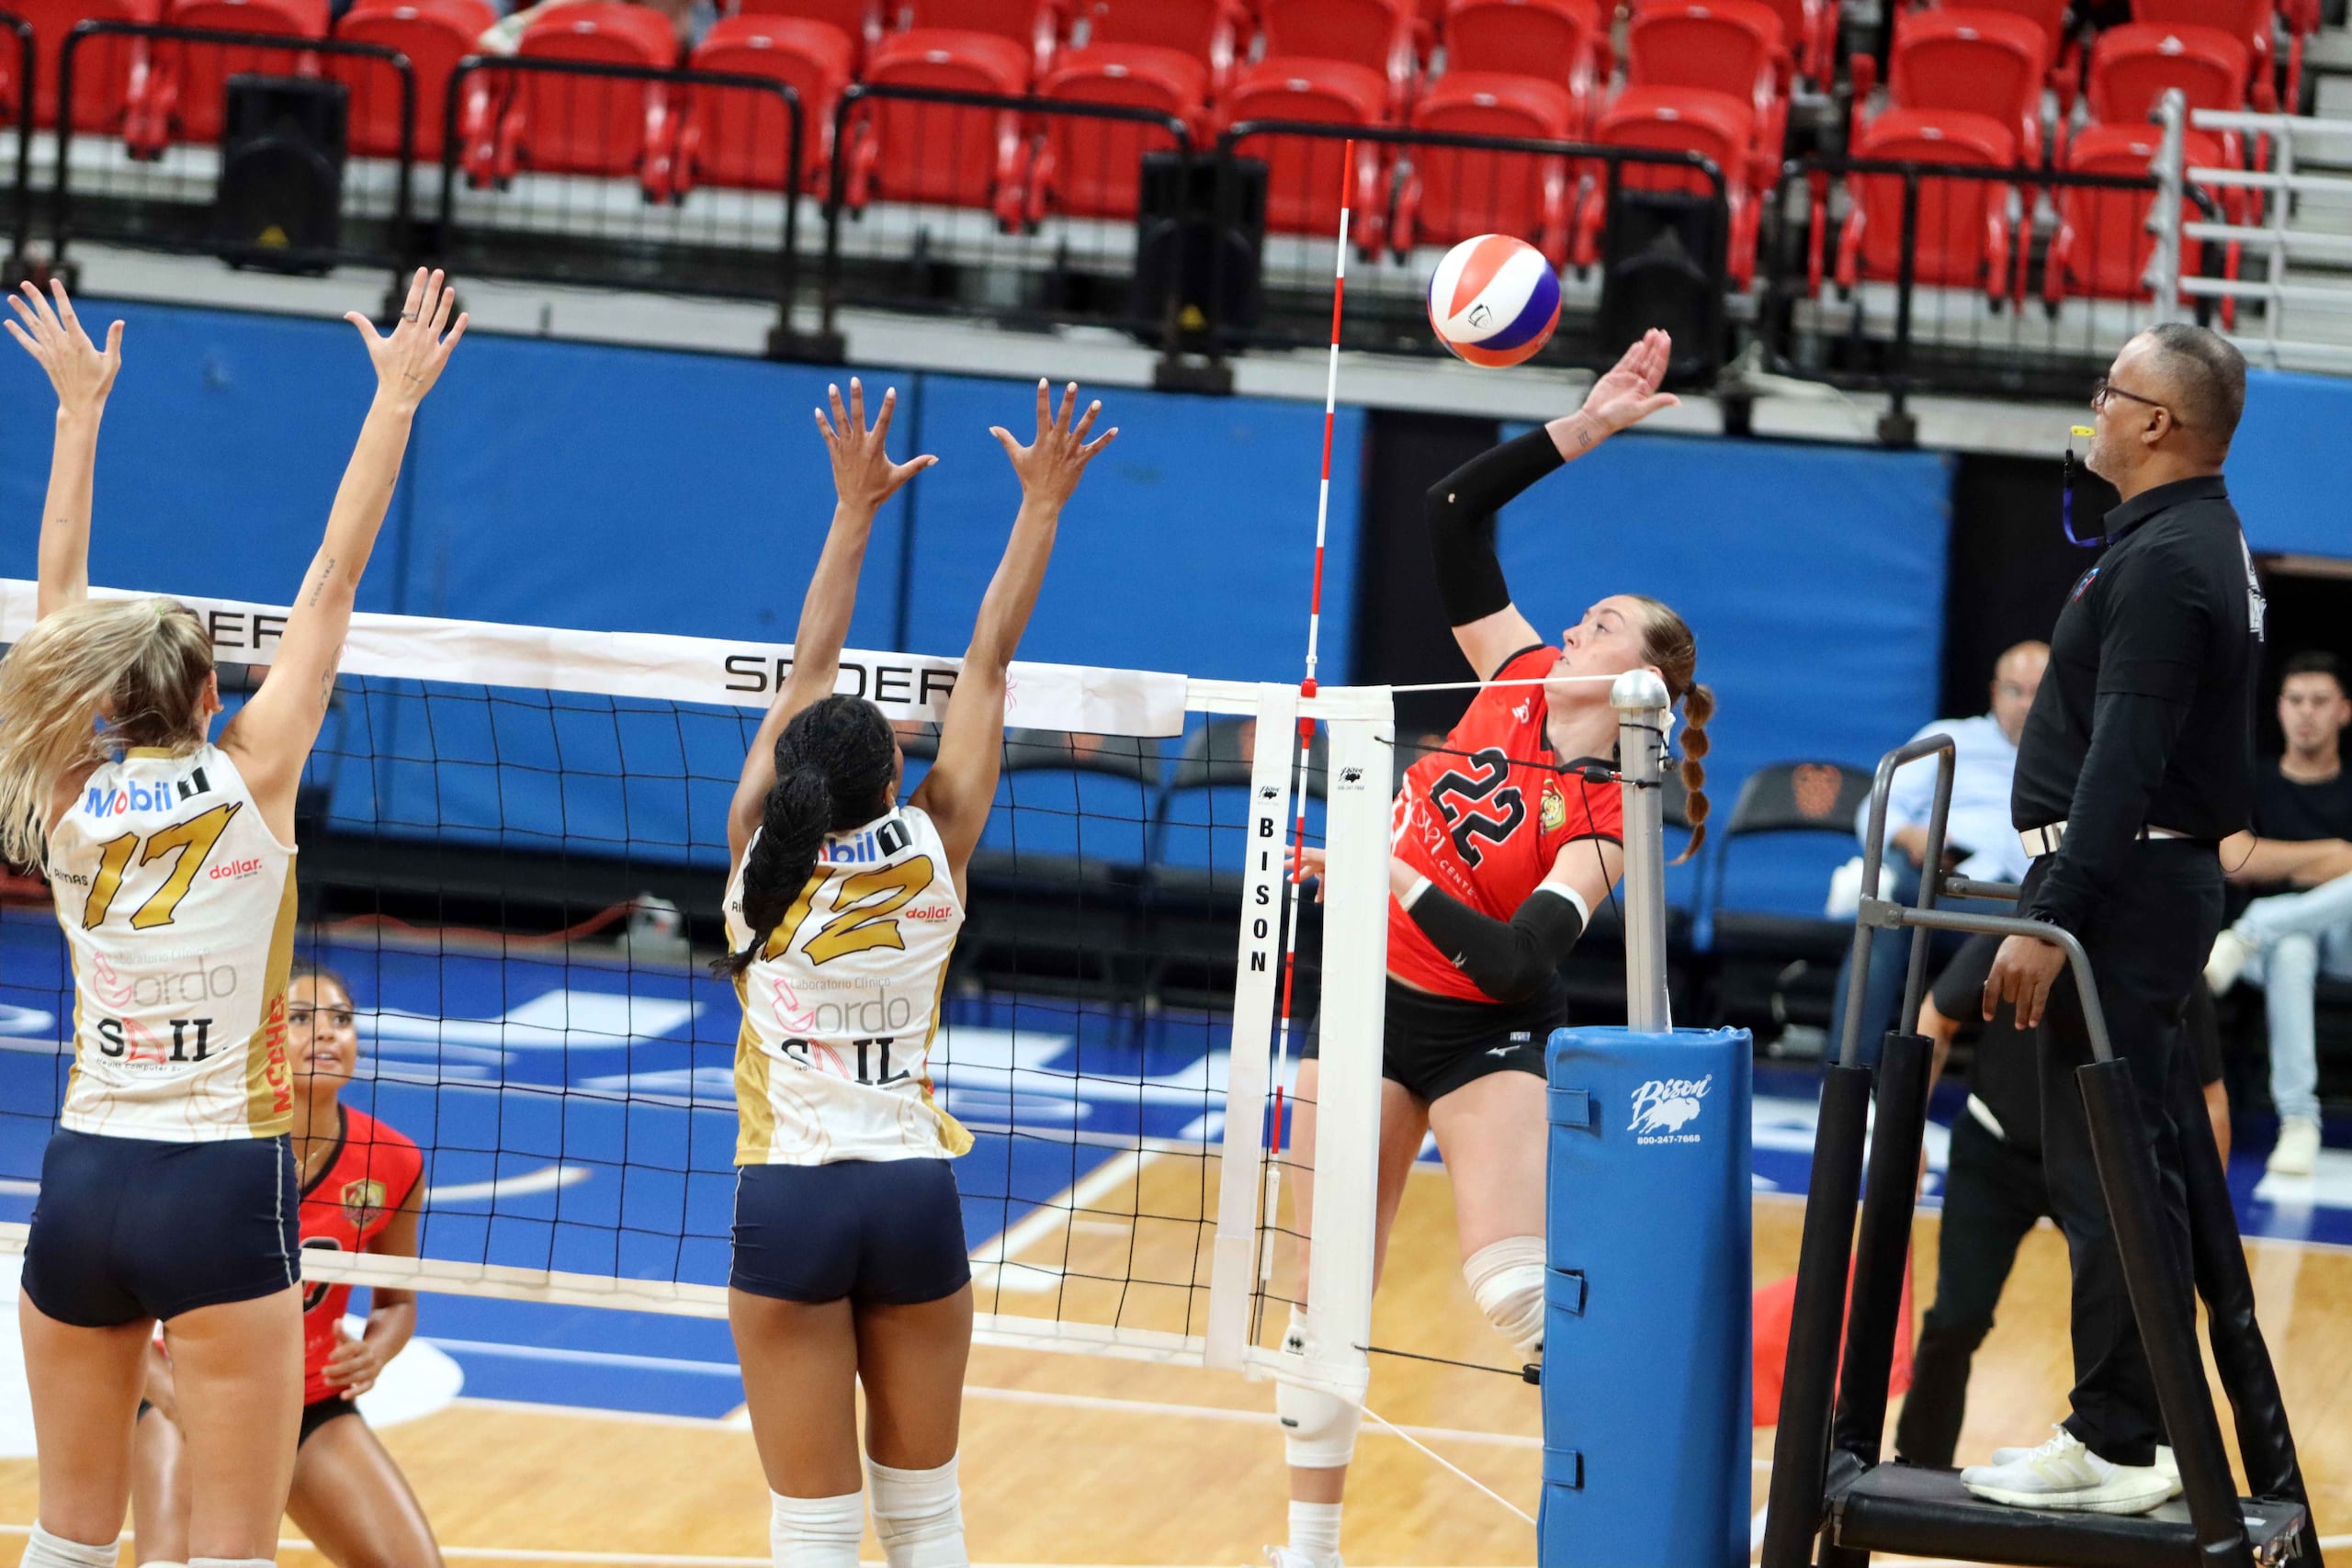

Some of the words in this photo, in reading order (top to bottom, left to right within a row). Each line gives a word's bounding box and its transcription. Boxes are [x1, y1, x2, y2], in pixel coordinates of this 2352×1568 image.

[725, 655, 961, 705] SDER
[84, 780, 173, 818] Mobil
[1430, 746, 1527, 870] 22
[81, 801, 243, 931] 17
[761, 854, 934, 965] 12
[1250, 817, 1274, 972] BISON
[790, 977, 852, 991] Laboratorio
[124, 1062, 168, 1072] Computer
[1628, 1077, 1712, 1124] Bison
